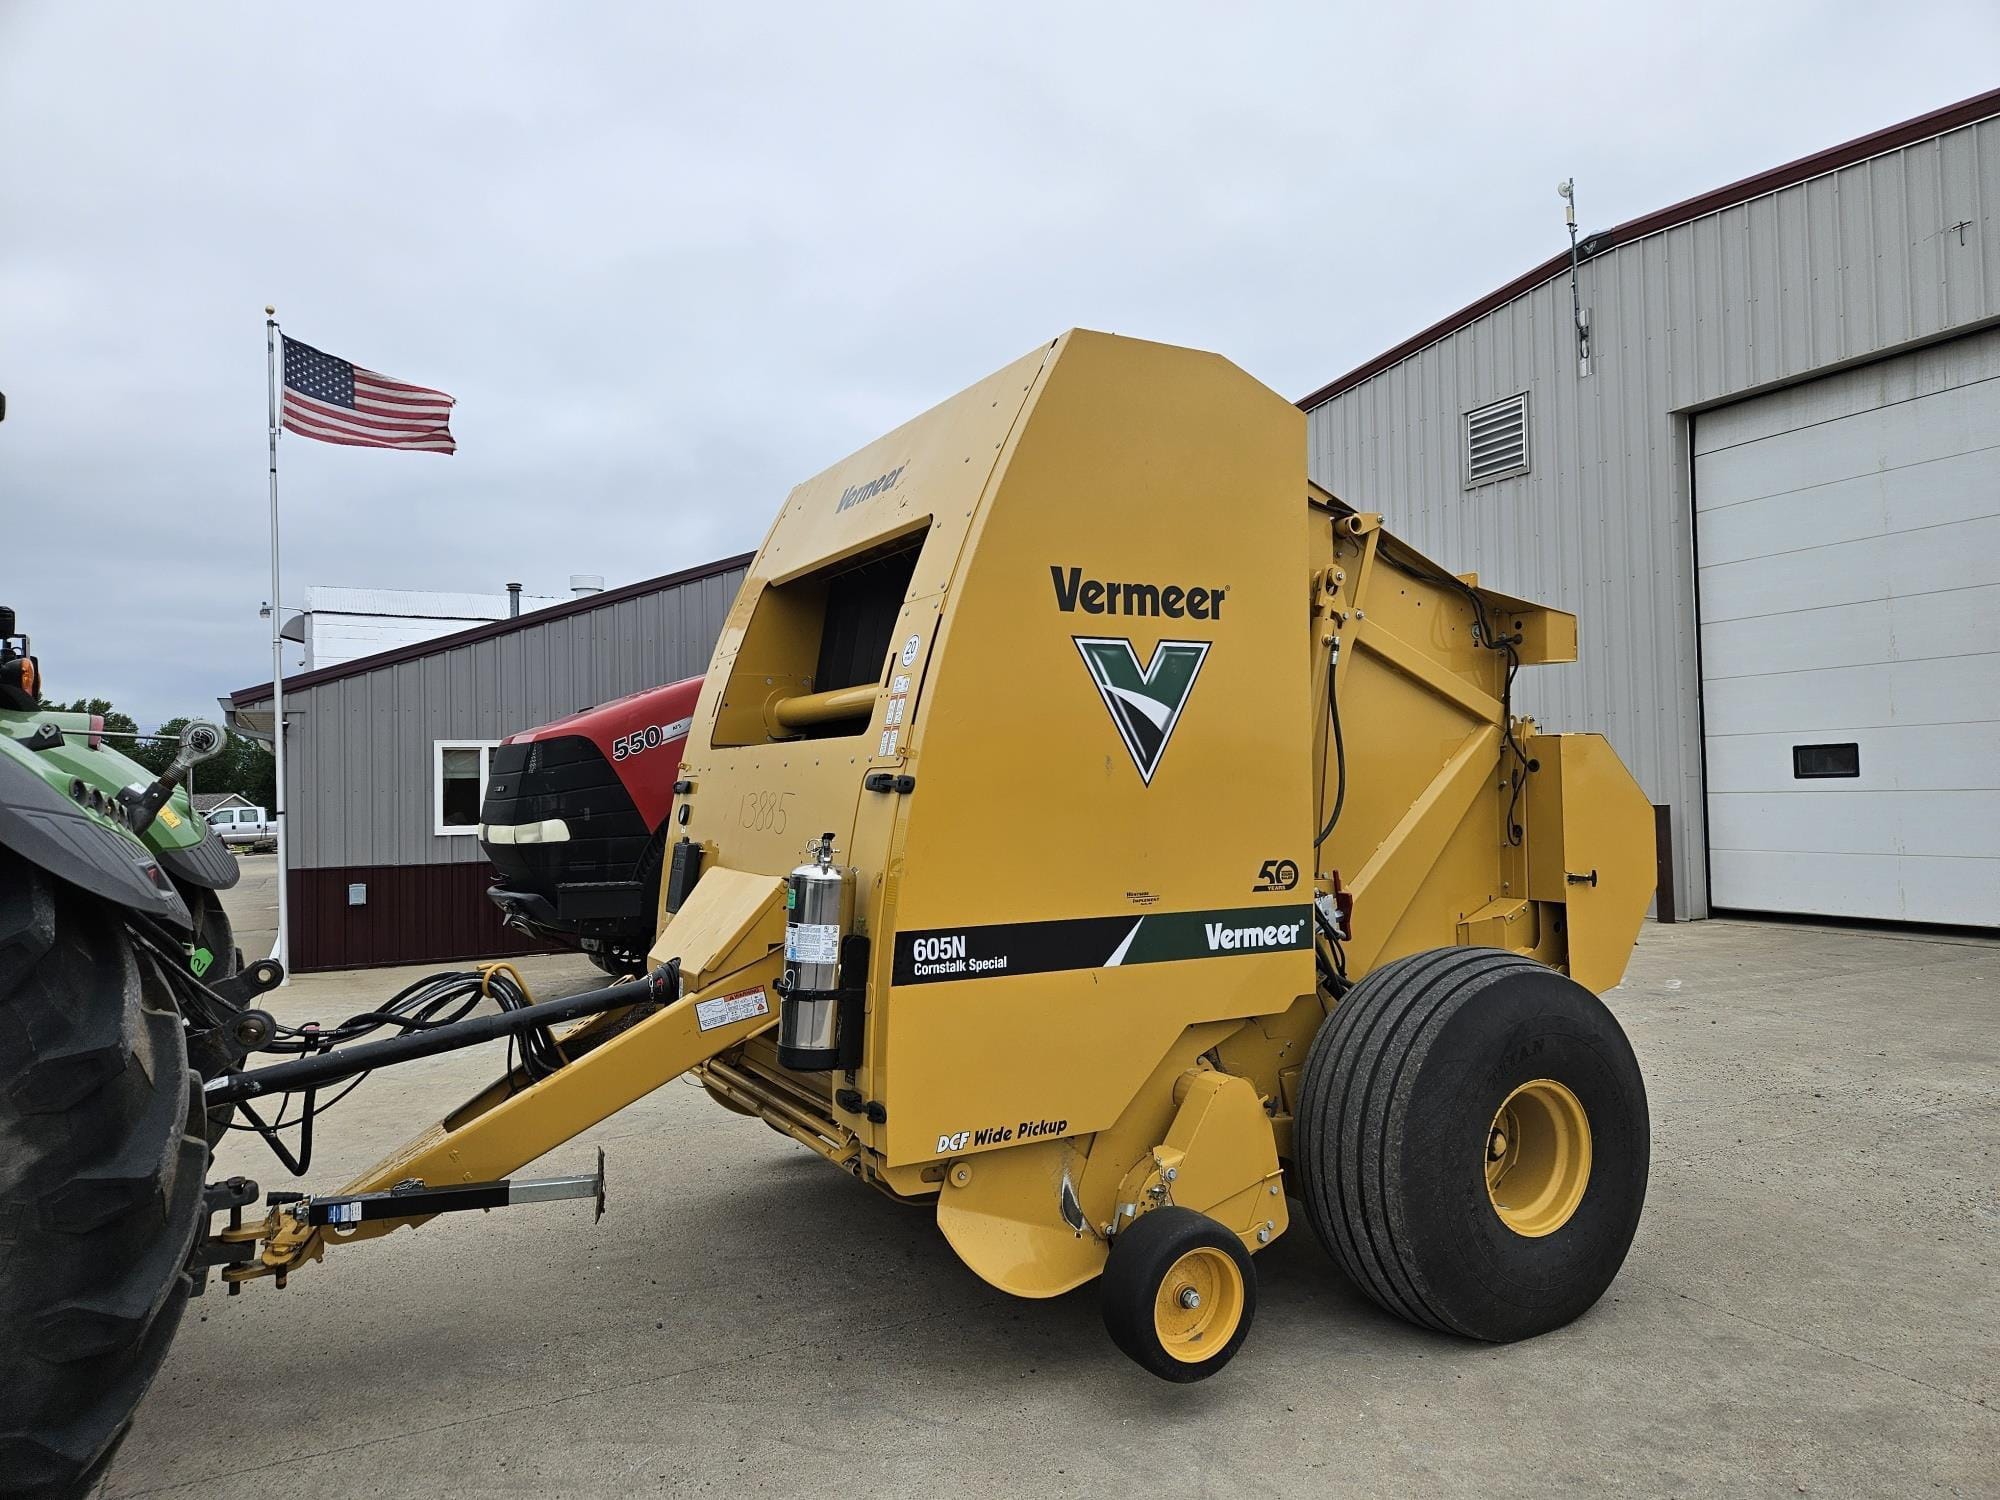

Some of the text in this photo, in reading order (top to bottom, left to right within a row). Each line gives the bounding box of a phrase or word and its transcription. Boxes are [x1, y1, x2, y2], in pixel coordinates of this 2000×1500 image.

[835, 465, 905, 514] Vermeer
[1050, 565, 1226, 619] Vermeer
[905, 640, 917, 655] 20
[612, 725, 661, 761] 550
[738, 790, 796, 834] 13885
[913, 935, 966, 961] 605N
[1204, 922, 1300, 950] Vermeer
[914, 955, 1007, 976] Cornstalk Special
[936, 1119, 1067, 1154] DCF Wide Pickup
